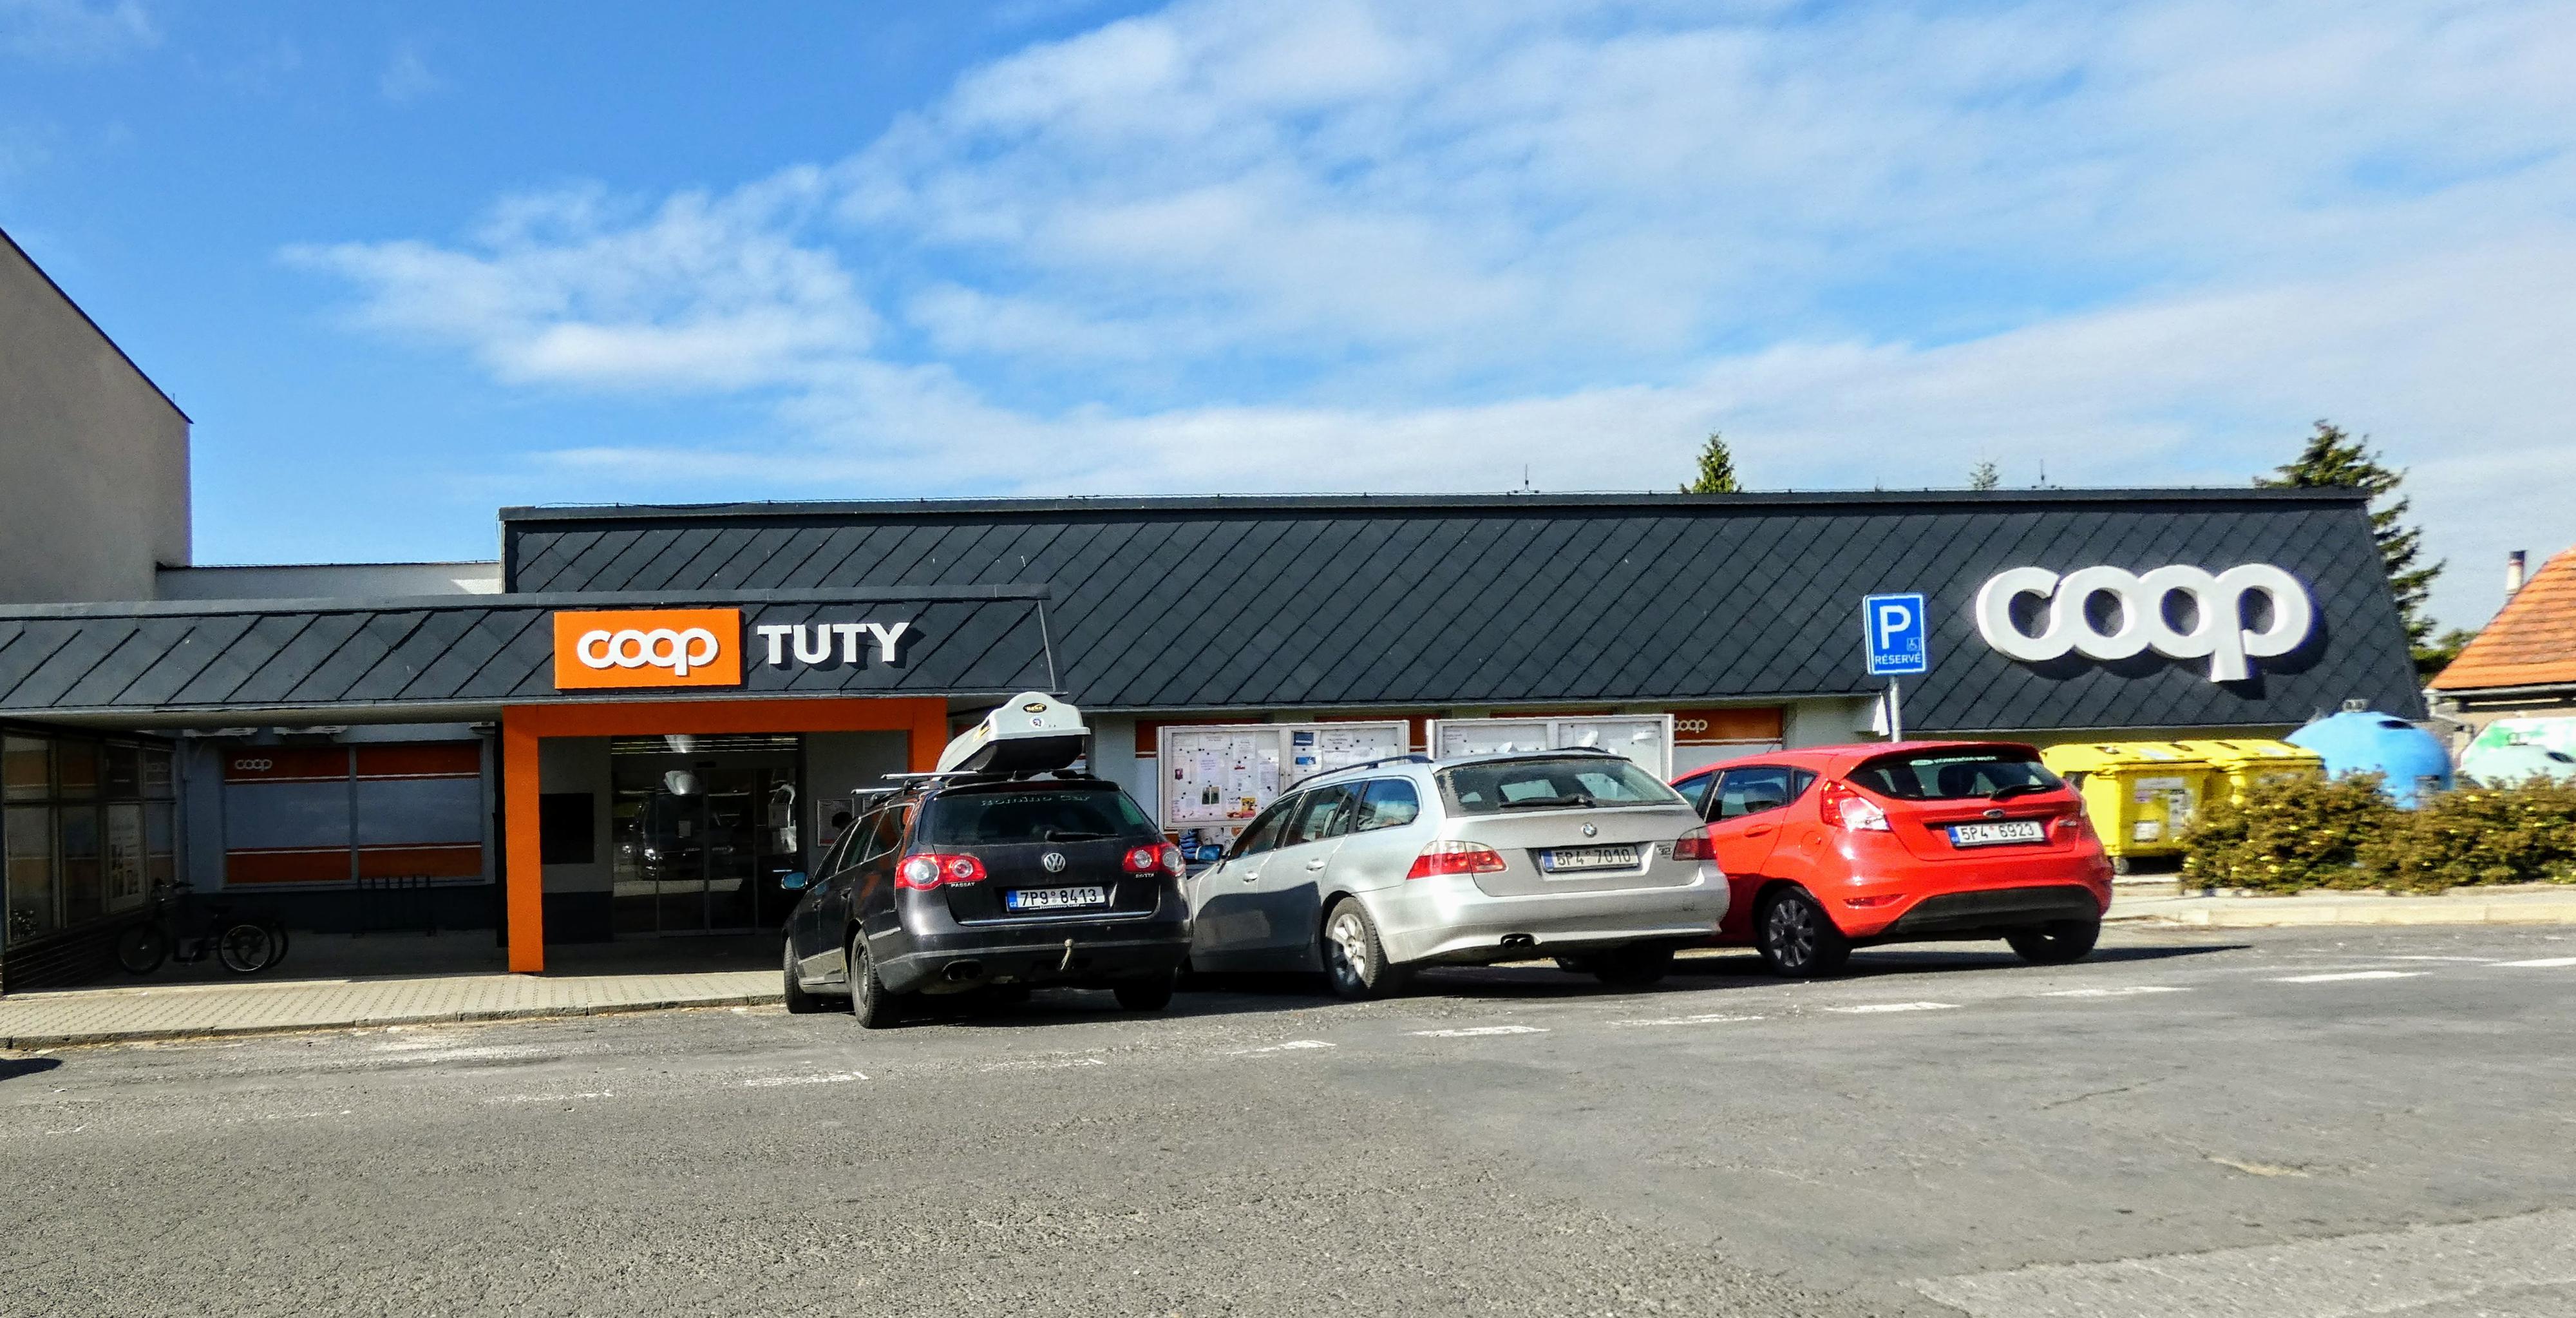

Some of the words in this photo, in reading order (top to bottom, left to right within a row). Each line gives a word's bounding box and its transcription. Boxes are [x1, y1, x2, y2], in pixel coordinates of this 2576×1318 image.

[1879, 604, 1911, 650] P
[1975, 563, 2312, 683] coop
[576, 627, 720, 676] coop
[757, 622, 909, 665] TUTY
[1875, 652, 1922, 665] RÉSERVÉ
[234, 758, 273, 772] coop
[1961, 826, 1988, 840] 5P4
[1998, 823, 2034, 837] 6923
[1555, 850, 1584, 866] 5P4
[1594, 848, 1631, 864] 7010
[1020, 891, 1048, 906] 7P9
[1059, 888, 1097, 904] 8413
